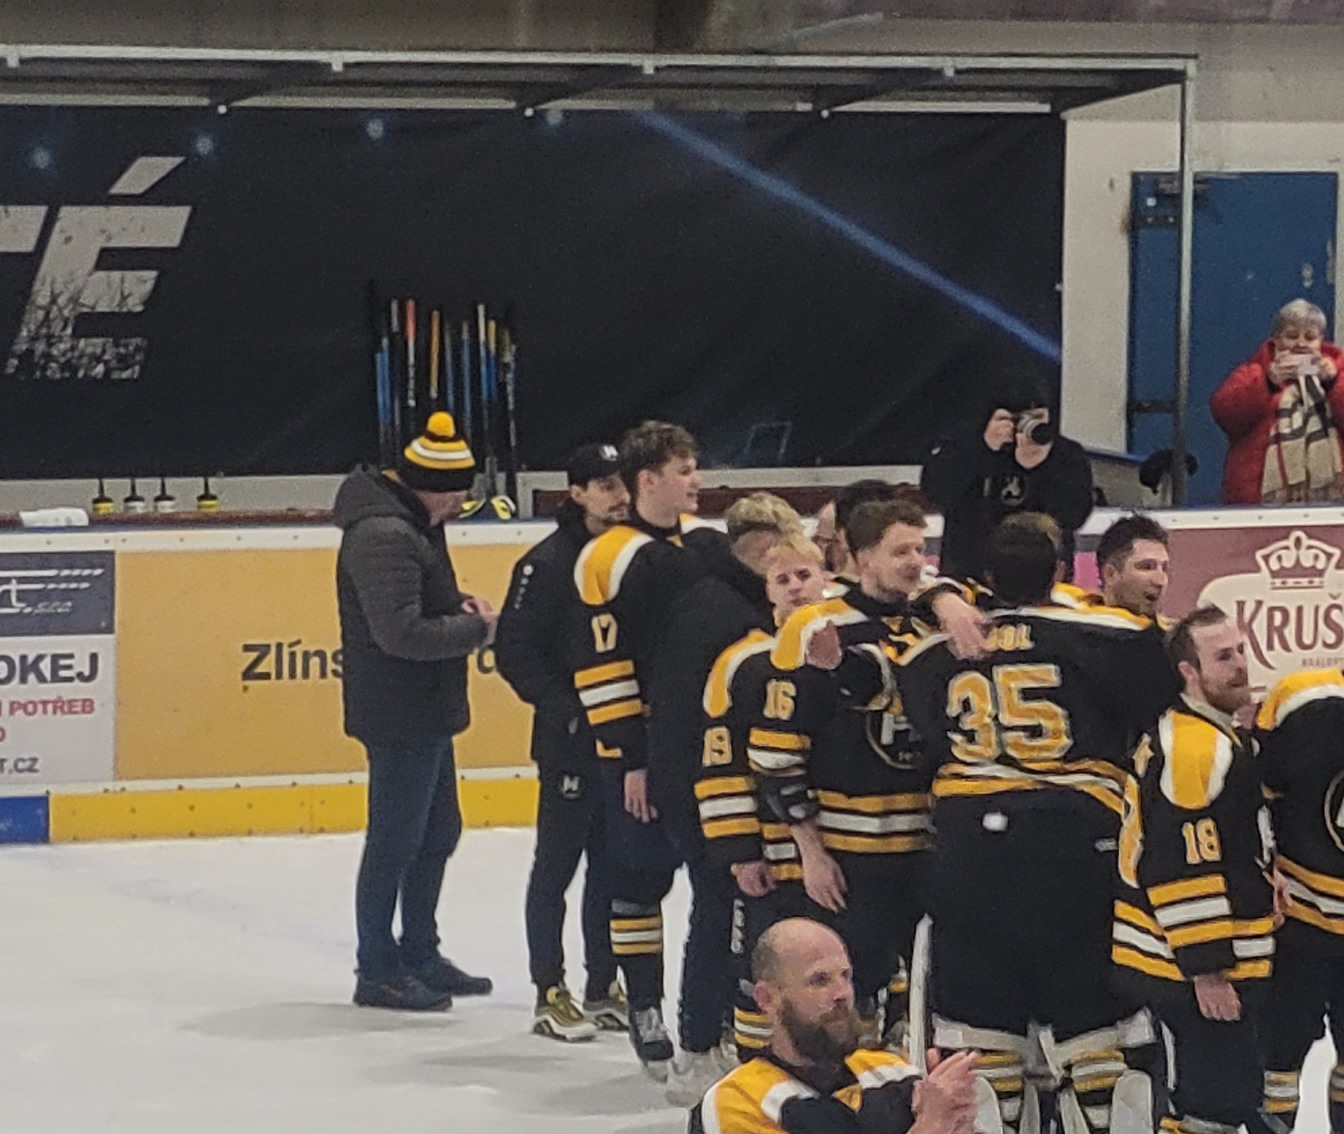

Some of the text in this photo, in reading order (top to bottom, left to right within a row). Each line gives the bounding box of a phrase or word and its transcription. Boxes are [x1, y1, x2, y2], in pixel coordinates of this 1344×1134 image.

[241, 638, 344, 684] Zlíns
[8, 696, 95, 717] POTŘEB
[946, 662, 1075, 764] 35
[1181, 817, 1222, 865] 18
